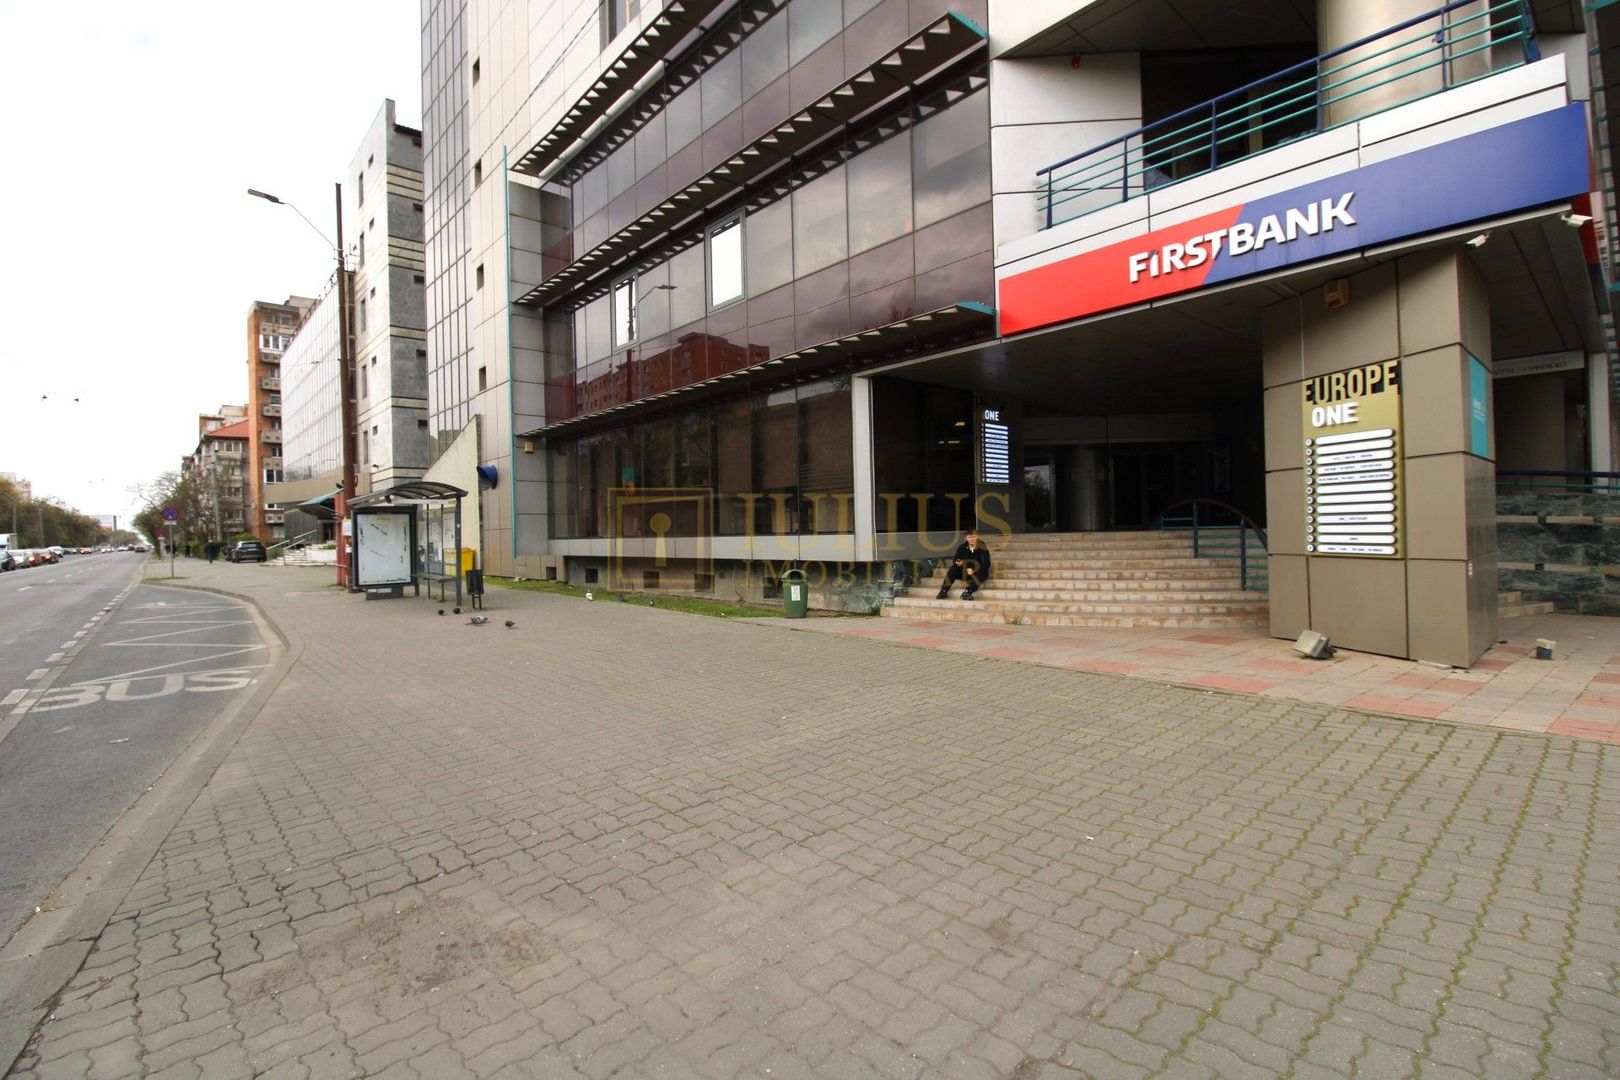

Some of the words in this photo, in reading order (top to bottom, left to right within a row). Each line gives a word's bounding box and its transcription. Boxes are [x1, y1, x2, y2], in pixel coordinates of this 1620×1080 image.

[1303, 360, 1400, 404] EUROPE
[985, 409, 1000, 421] ONE
[1311, 402, 1359, 427] ONE
[26, 669, 254, 714] BUS
